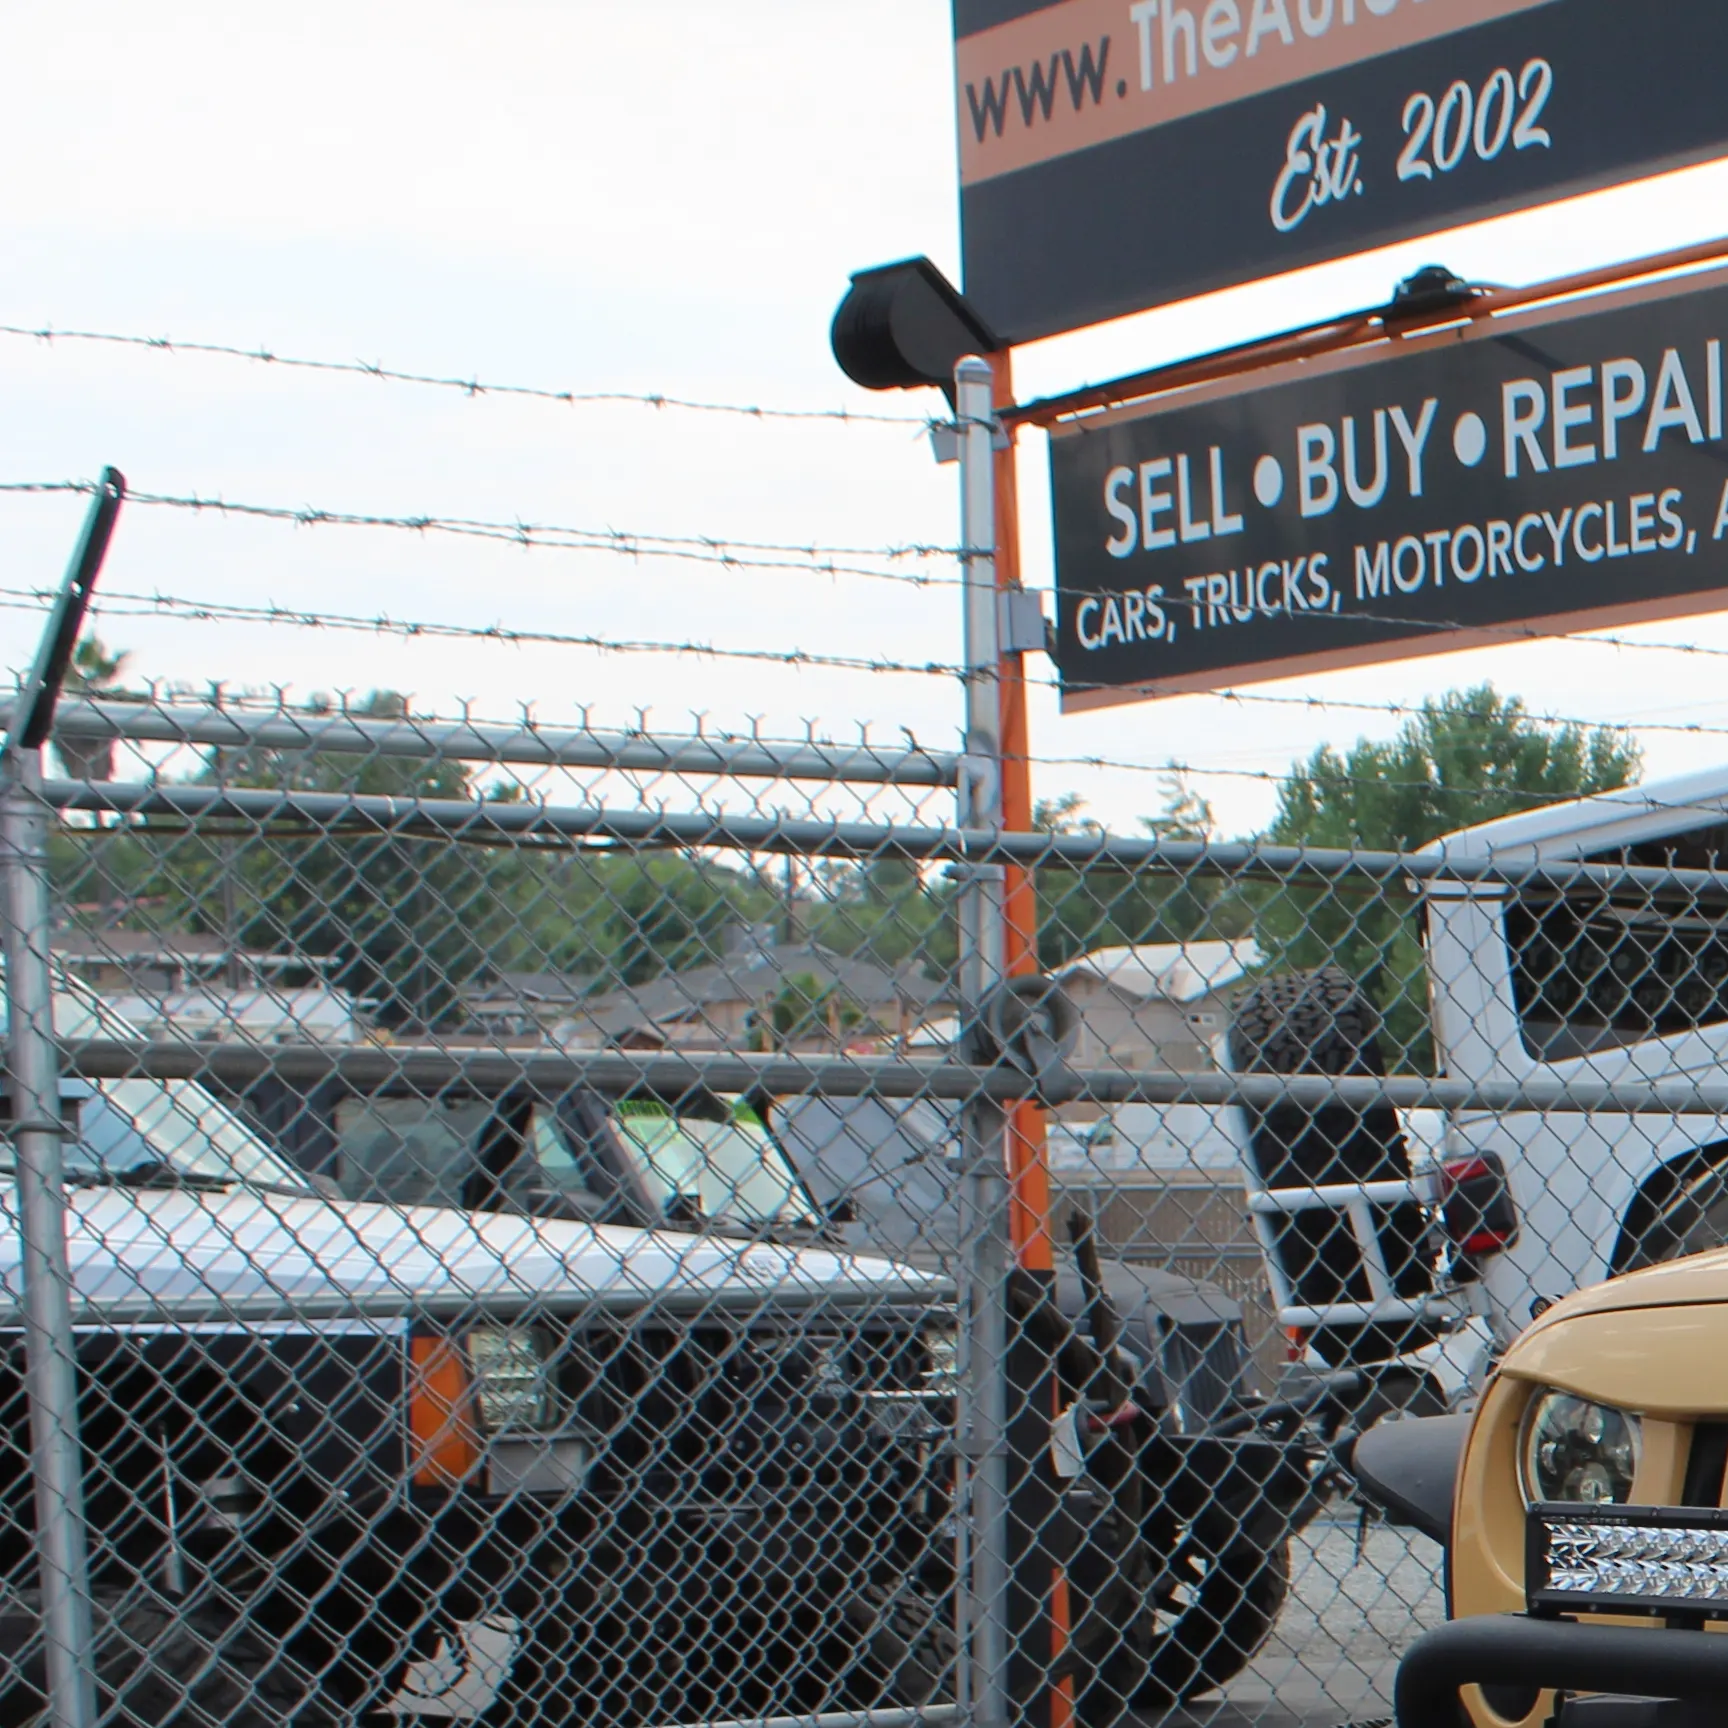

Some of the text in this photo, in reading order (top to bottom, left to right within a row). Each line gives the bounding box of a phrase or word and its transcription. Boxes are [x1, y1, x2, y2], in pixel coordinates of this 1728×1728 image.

[1271, 58, 1552, 231] Est. 2002
[1104, 446, 1244, 558] SELL
[1297, 397, 1438, 518] BUY
[1076, 584, 1176, 650] CARS,
[1184, 552, 1341, 630] TRUCKS,
[1354, 488, 1696, 600] MOTORCYCLES,
